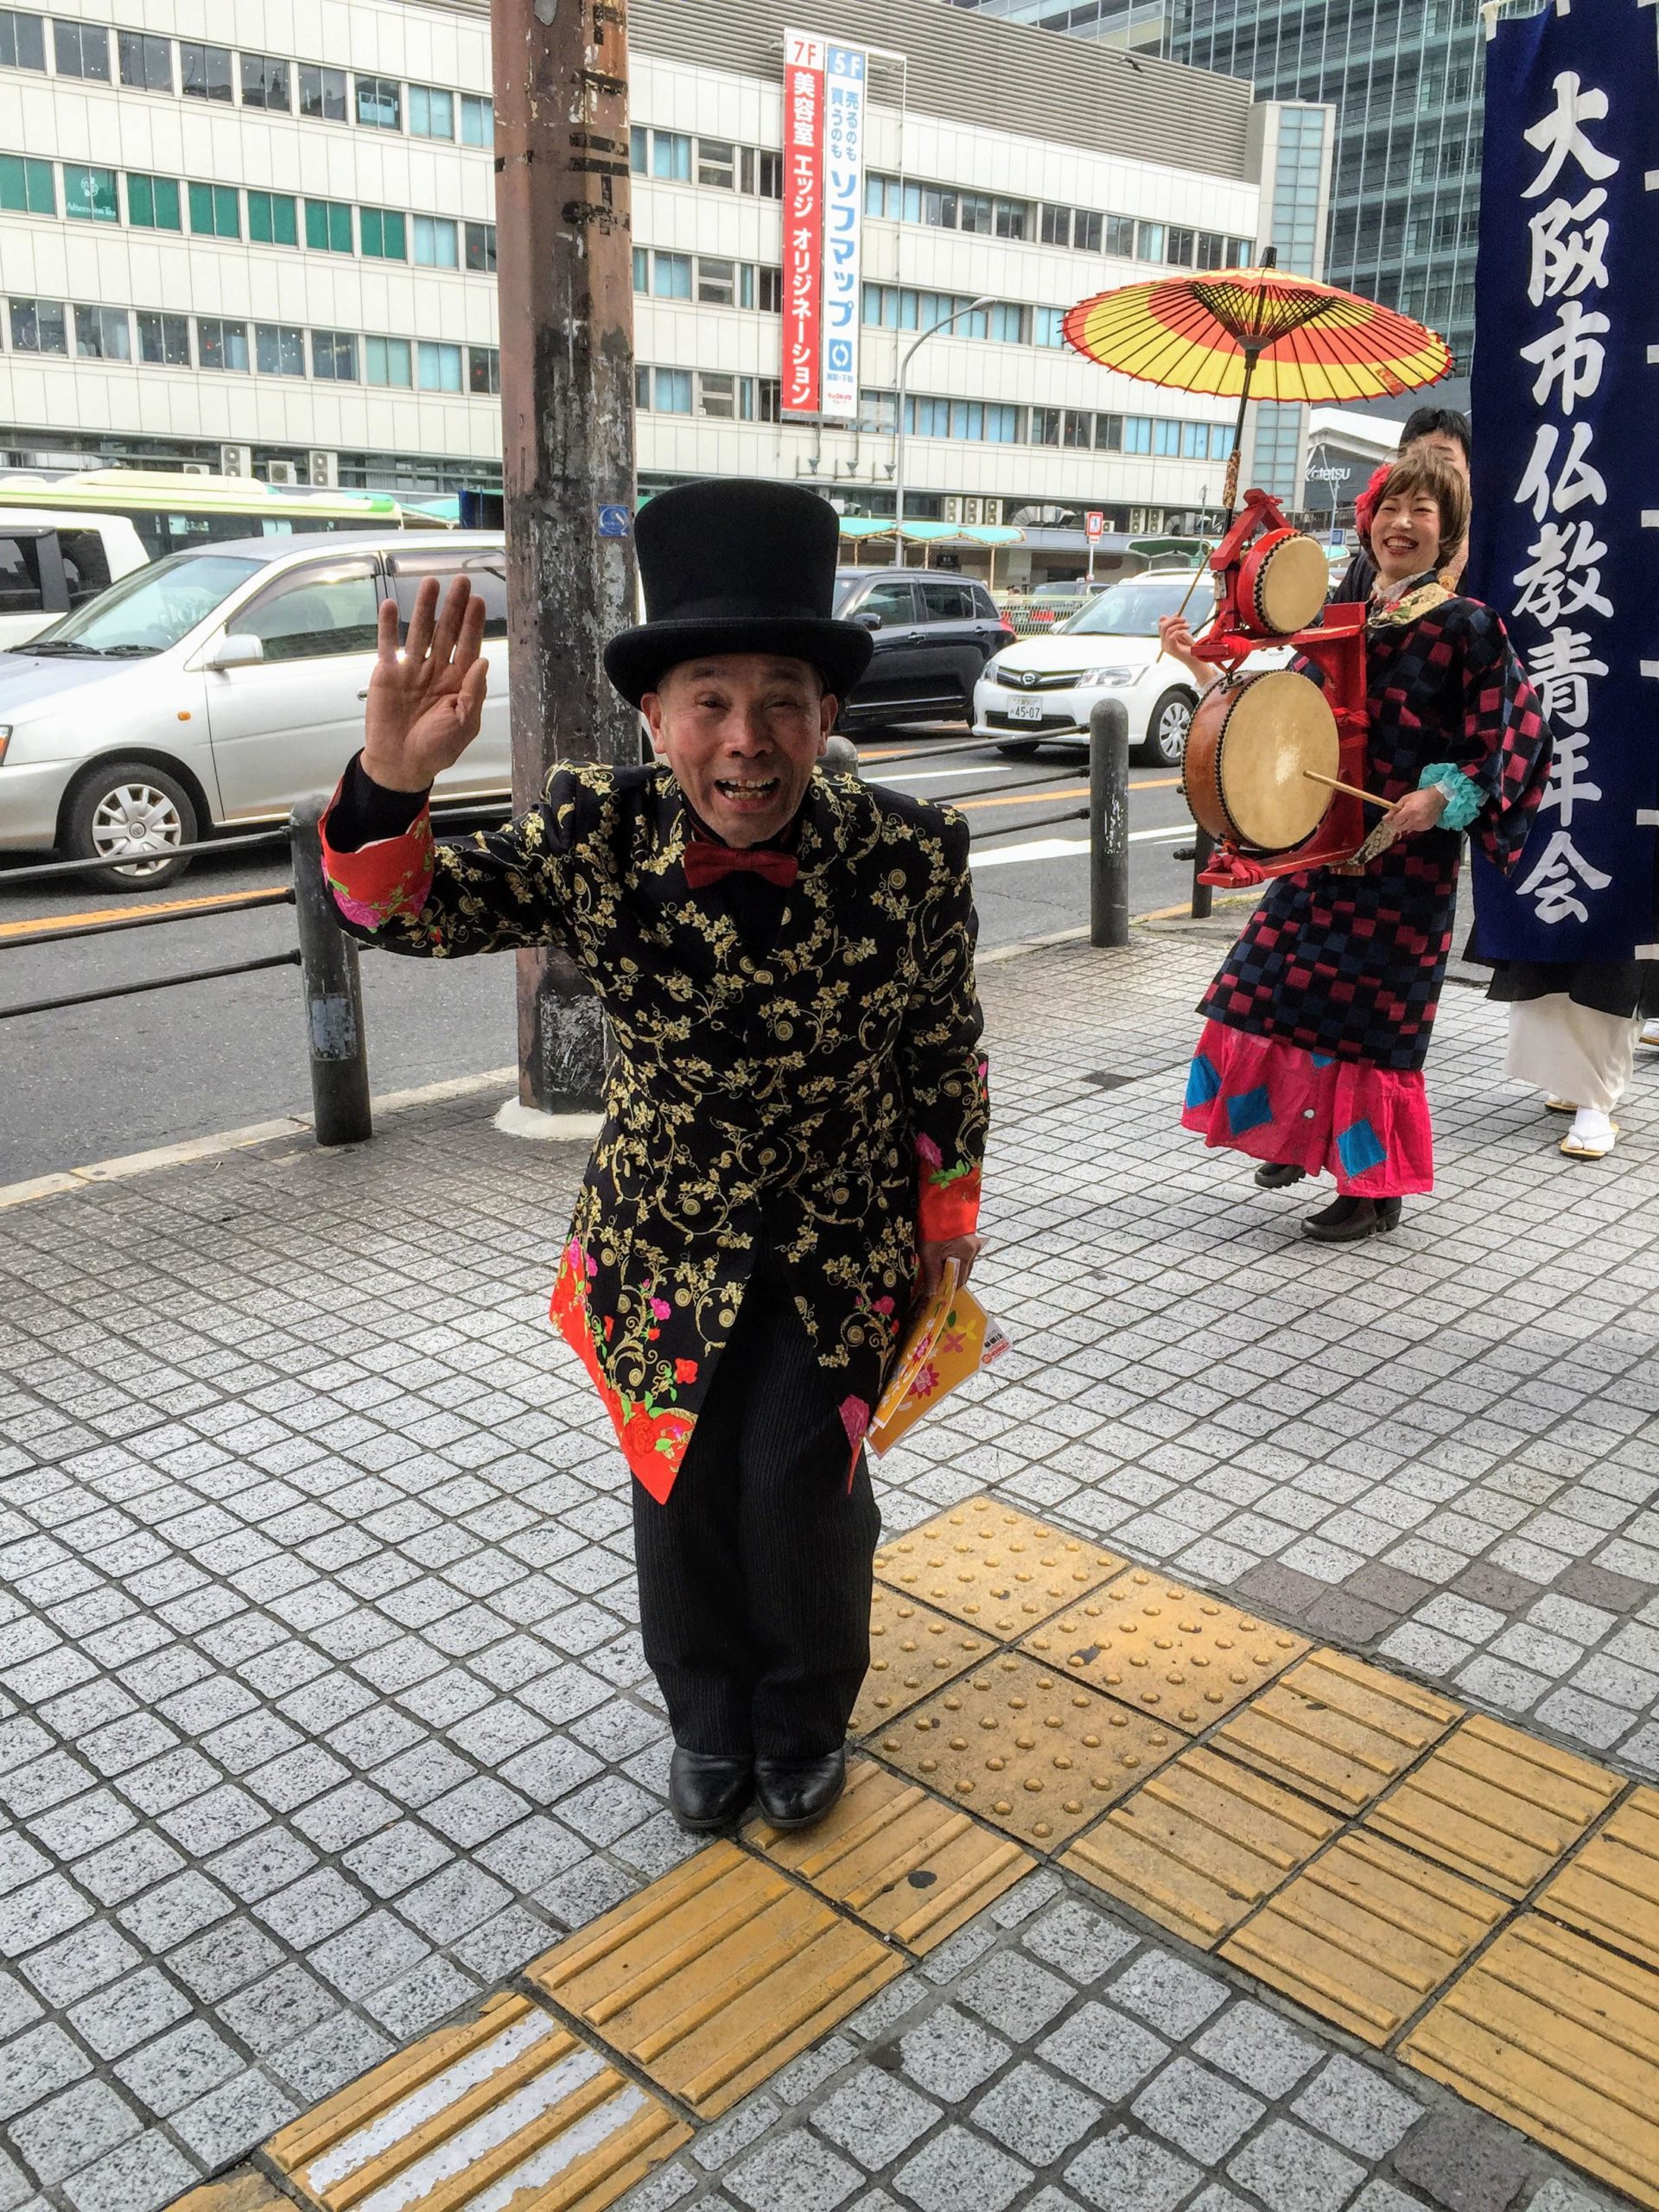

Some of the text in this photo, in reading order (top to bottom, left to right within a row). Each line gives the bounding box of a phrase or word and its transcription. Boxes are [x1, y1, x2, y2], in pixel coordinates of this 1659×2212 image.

[794, 41, 817, 66] 7F
[834, 52, 861, 77] 5F
[830, 87, 844, 159] 買うのも
[845, 91, 859, 162] 売るのも
[102, 206, 116, 216] Tea
[791, 72, 815, 404] 美容室 エッジ オリジネーション
[828, 170, 856, 327] ソフマップ
[1513, 70, 1620, 924] 大阪市仏教青年会
[1015, 706, 1040, 718] 45-07
